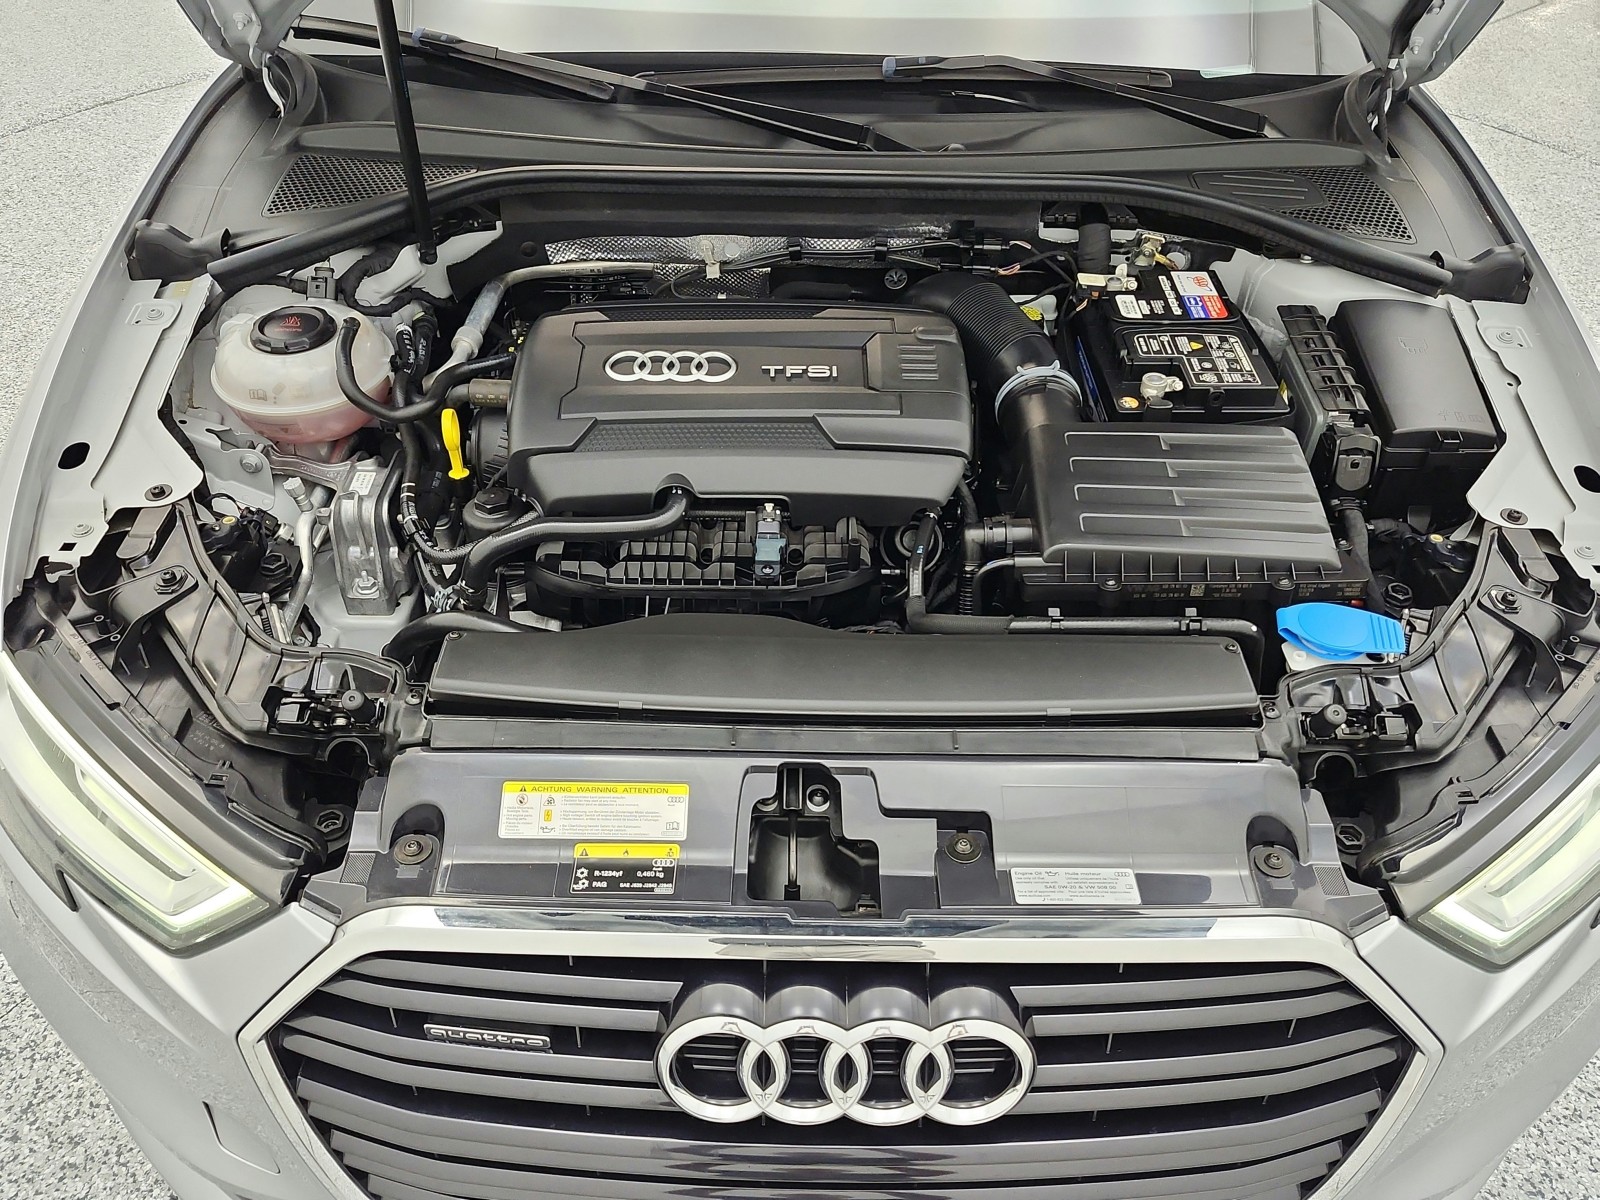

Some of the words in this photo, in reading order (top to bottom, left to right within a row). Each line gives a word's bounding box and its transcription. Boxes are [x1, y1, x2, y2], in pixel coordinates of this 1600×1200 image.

[761, 365, 838, 378] TFSI
[594, 870, 623, 878] R-1234yf
[430, 1028, 543, 1047] quattro
